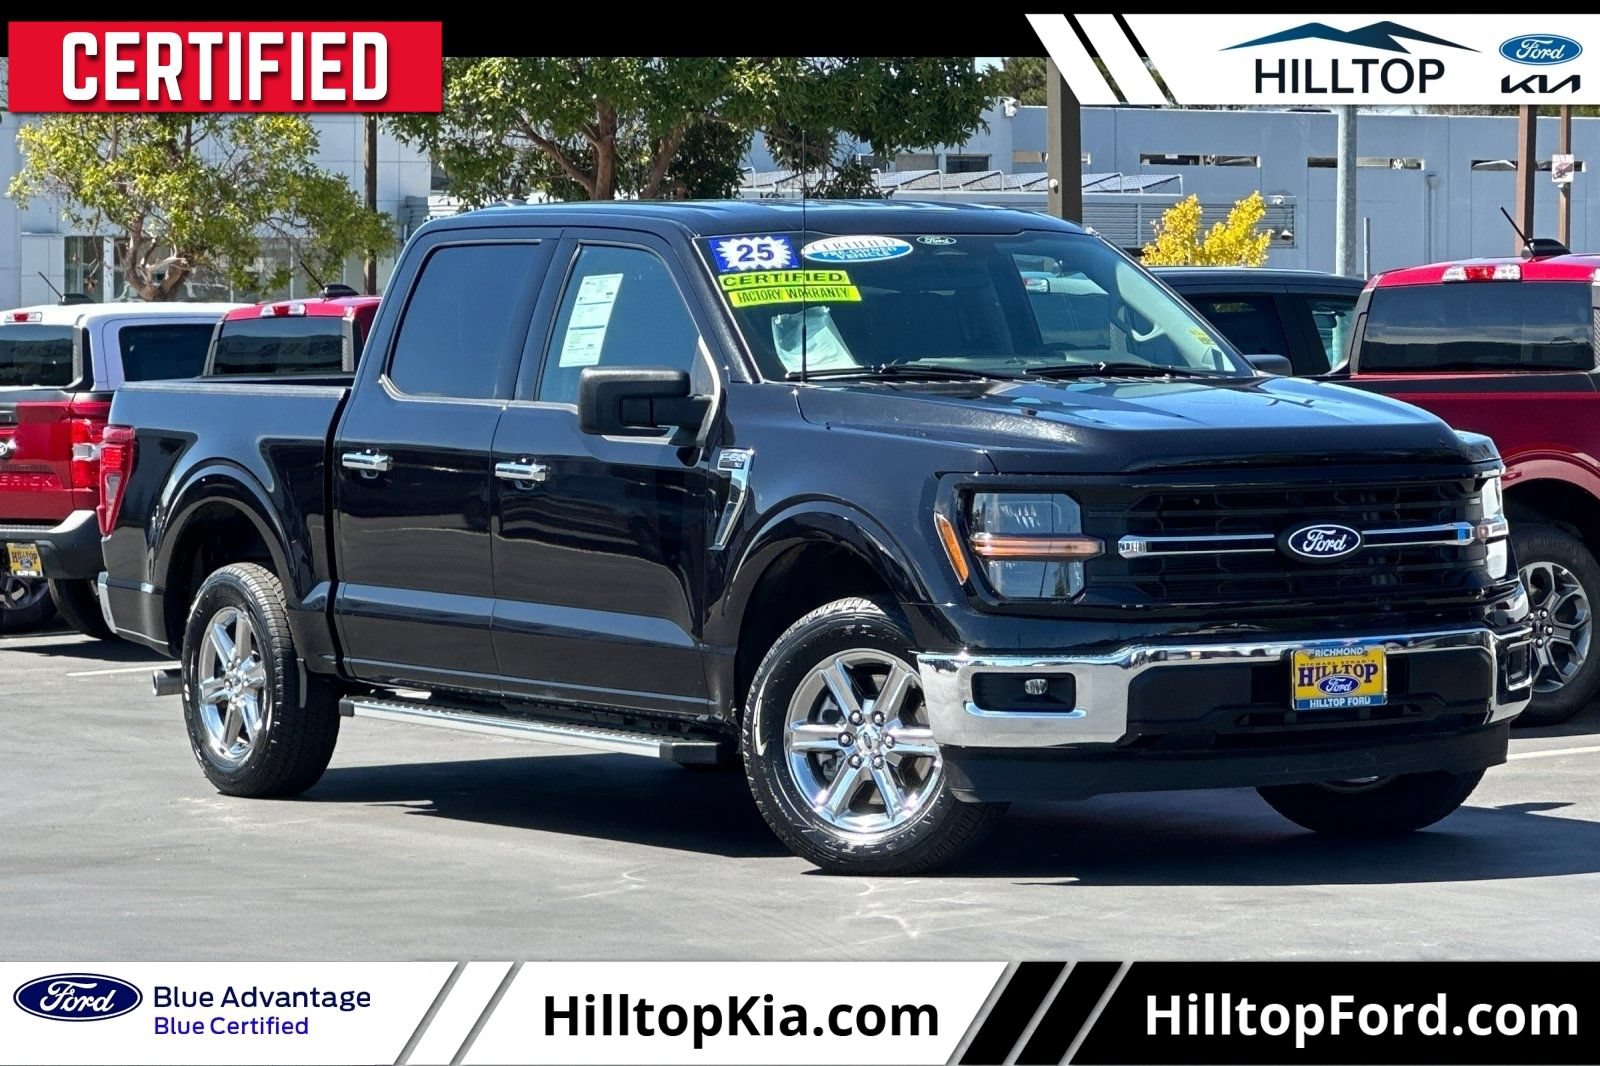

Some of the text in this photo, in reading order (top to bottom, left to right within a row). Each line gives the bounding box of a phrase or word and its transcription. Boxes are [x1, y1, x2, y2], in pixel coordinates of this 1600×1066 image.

[736, 243, 775, 262] 25
[837, 251, 892, 260] VEHICLE
[723, 272, 844, 287] CERTIFIED
[737, 286, 849, 303] FACTORY WARRANTY
[1303, 529, 1347, 552] Ford
[1314, 647, 1364, 657] RICHMOND
[1298, 663, 1379, 687] HILLTOP
[1325, 678, 1353, 692] Ford
[1309, 696, 1371, 708] HILLTOP FORD
